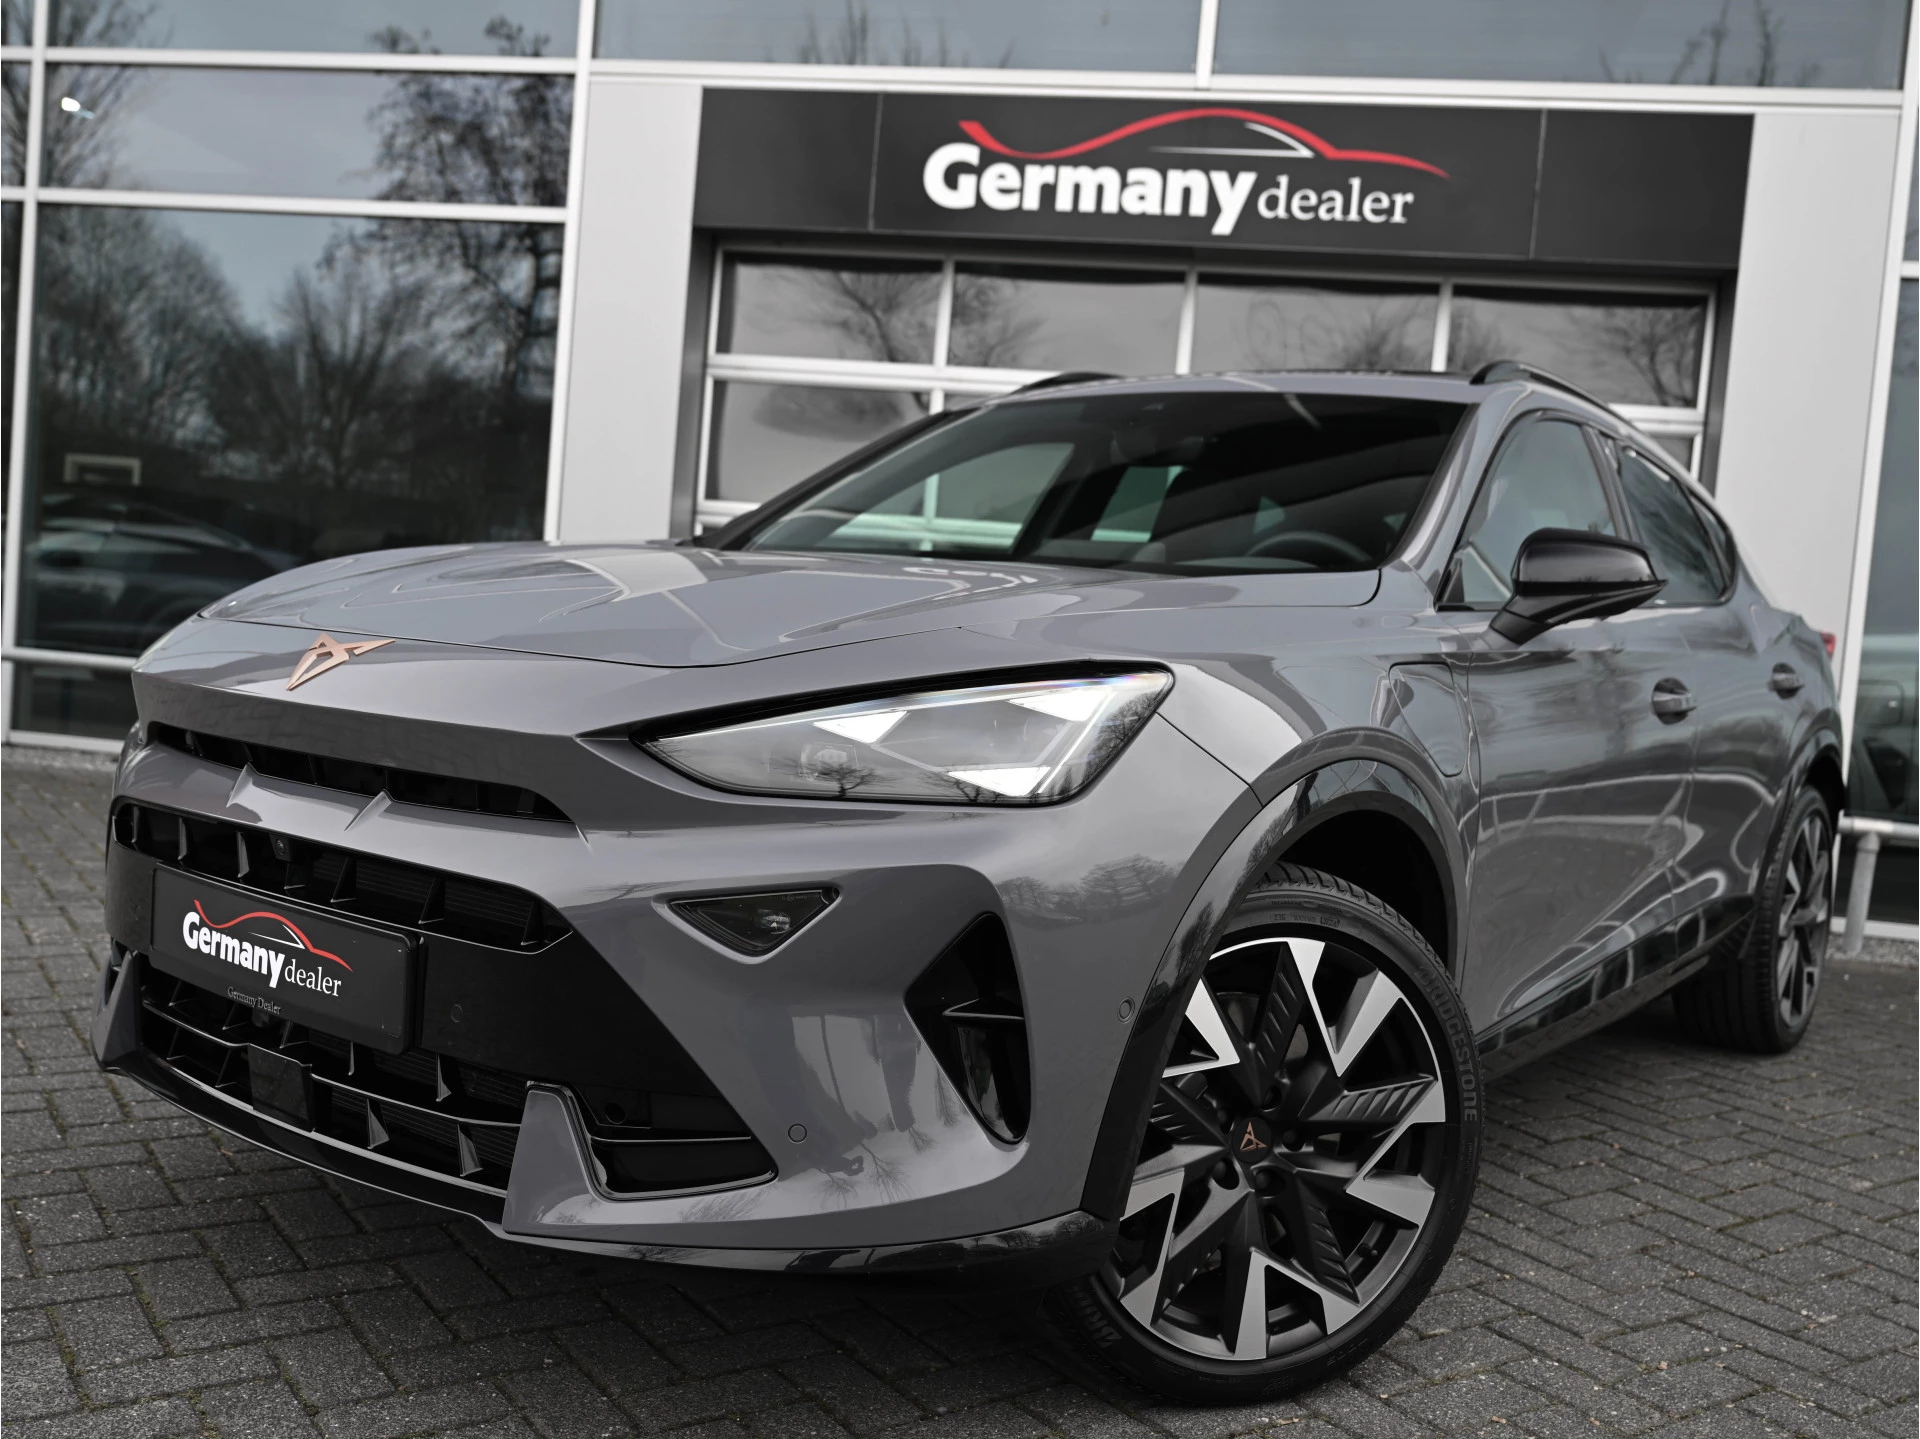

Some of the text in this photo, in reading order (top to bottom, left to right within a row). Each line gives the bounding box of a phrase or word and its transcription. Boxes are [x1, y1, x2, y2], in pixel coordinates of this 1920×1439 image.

[922, 142, 1415, 236] Germany dealer
[183, 911, 342, 997] Germany dealer
[227, 986, 281, 1015] Germany Dealer
[1414, 970, 1478, 1121] BRIDGESTONE
